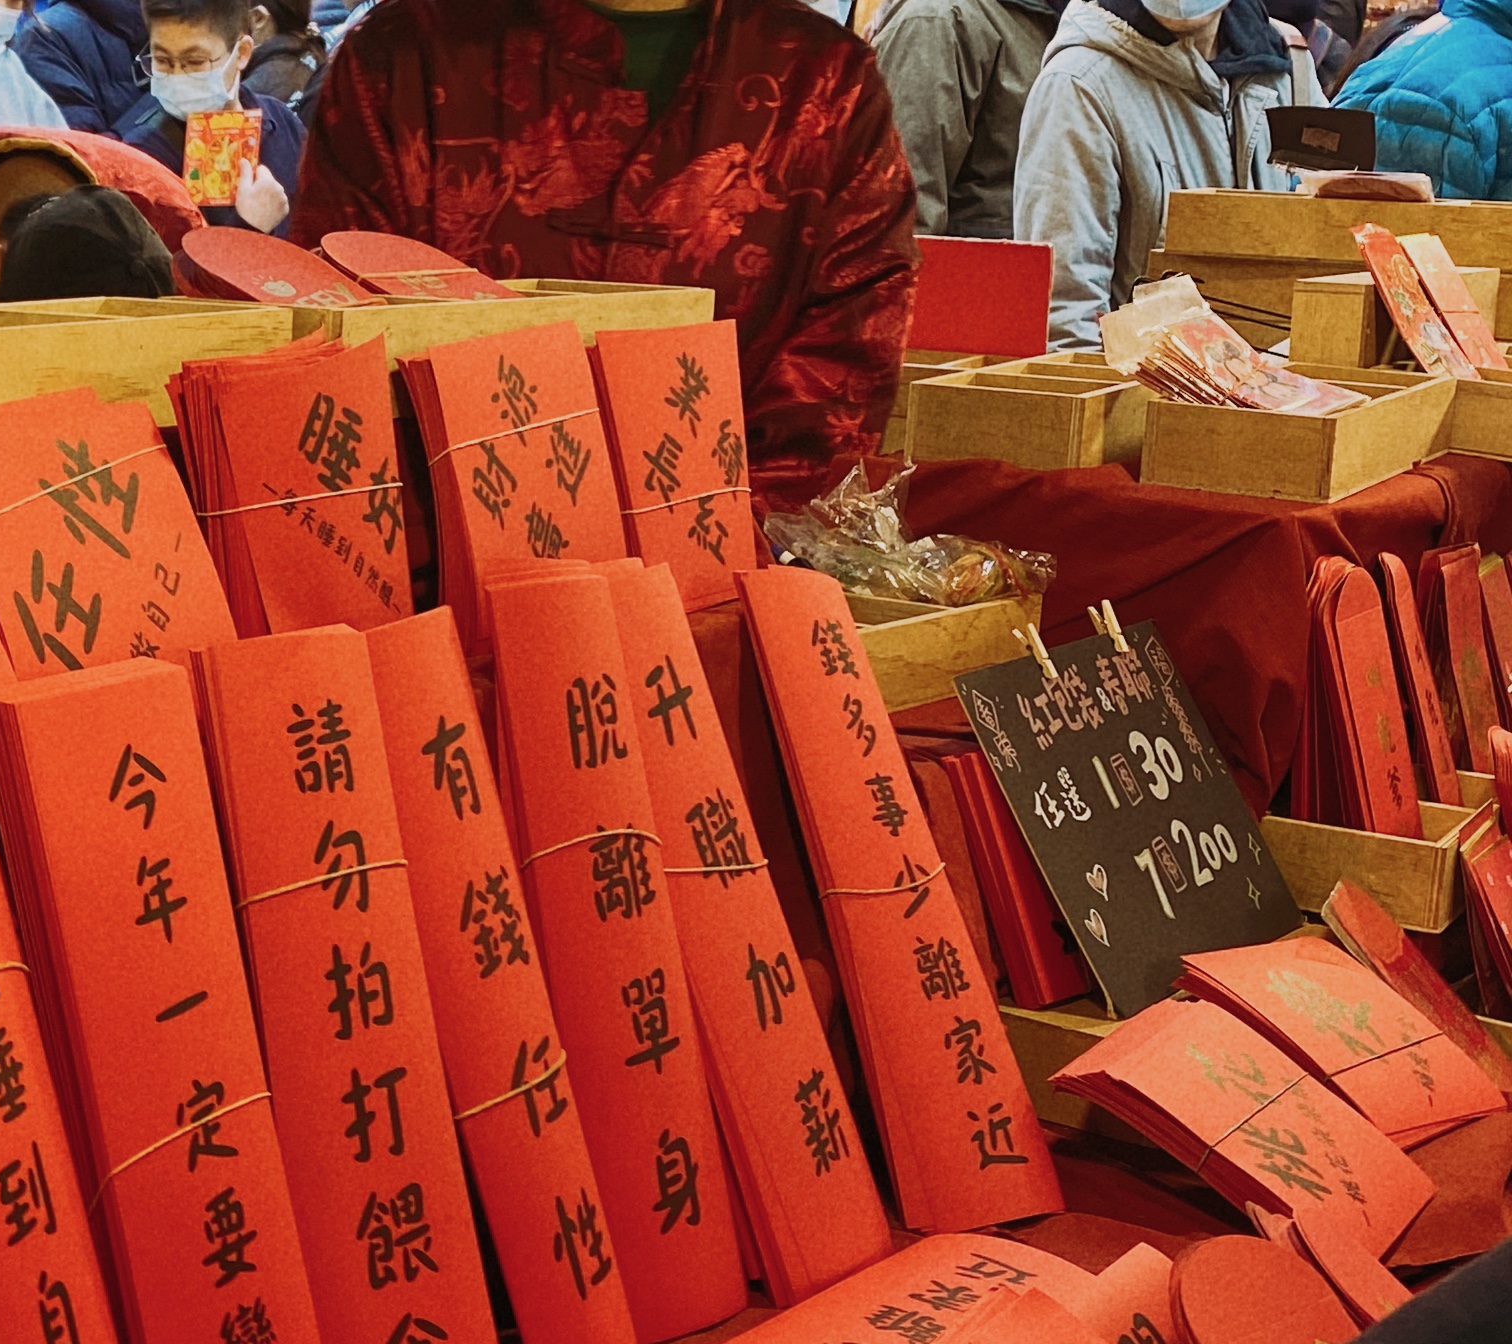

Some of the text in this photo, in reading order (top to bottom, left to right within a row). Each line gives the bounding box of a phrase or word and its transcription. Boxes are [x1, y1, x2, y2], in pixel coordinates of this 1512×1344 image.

[12, 435, 141, 674] 任性
[297, 390, 406, 558] 睡好
[467, 353, 541, 531] 財源
[810, 615, 1029, 1172] 錢多事少離家近
[1033, 766, 1092, 830] 任選
[1128, 729, 1184, 801] 30
[1170, 818, 1238, 887] 200
[421, 714, 613, 1302] 有錢任性
[566, 670, 703, 1235] 脫離單身
[643, 653, 850, 1178] 升職加薪
